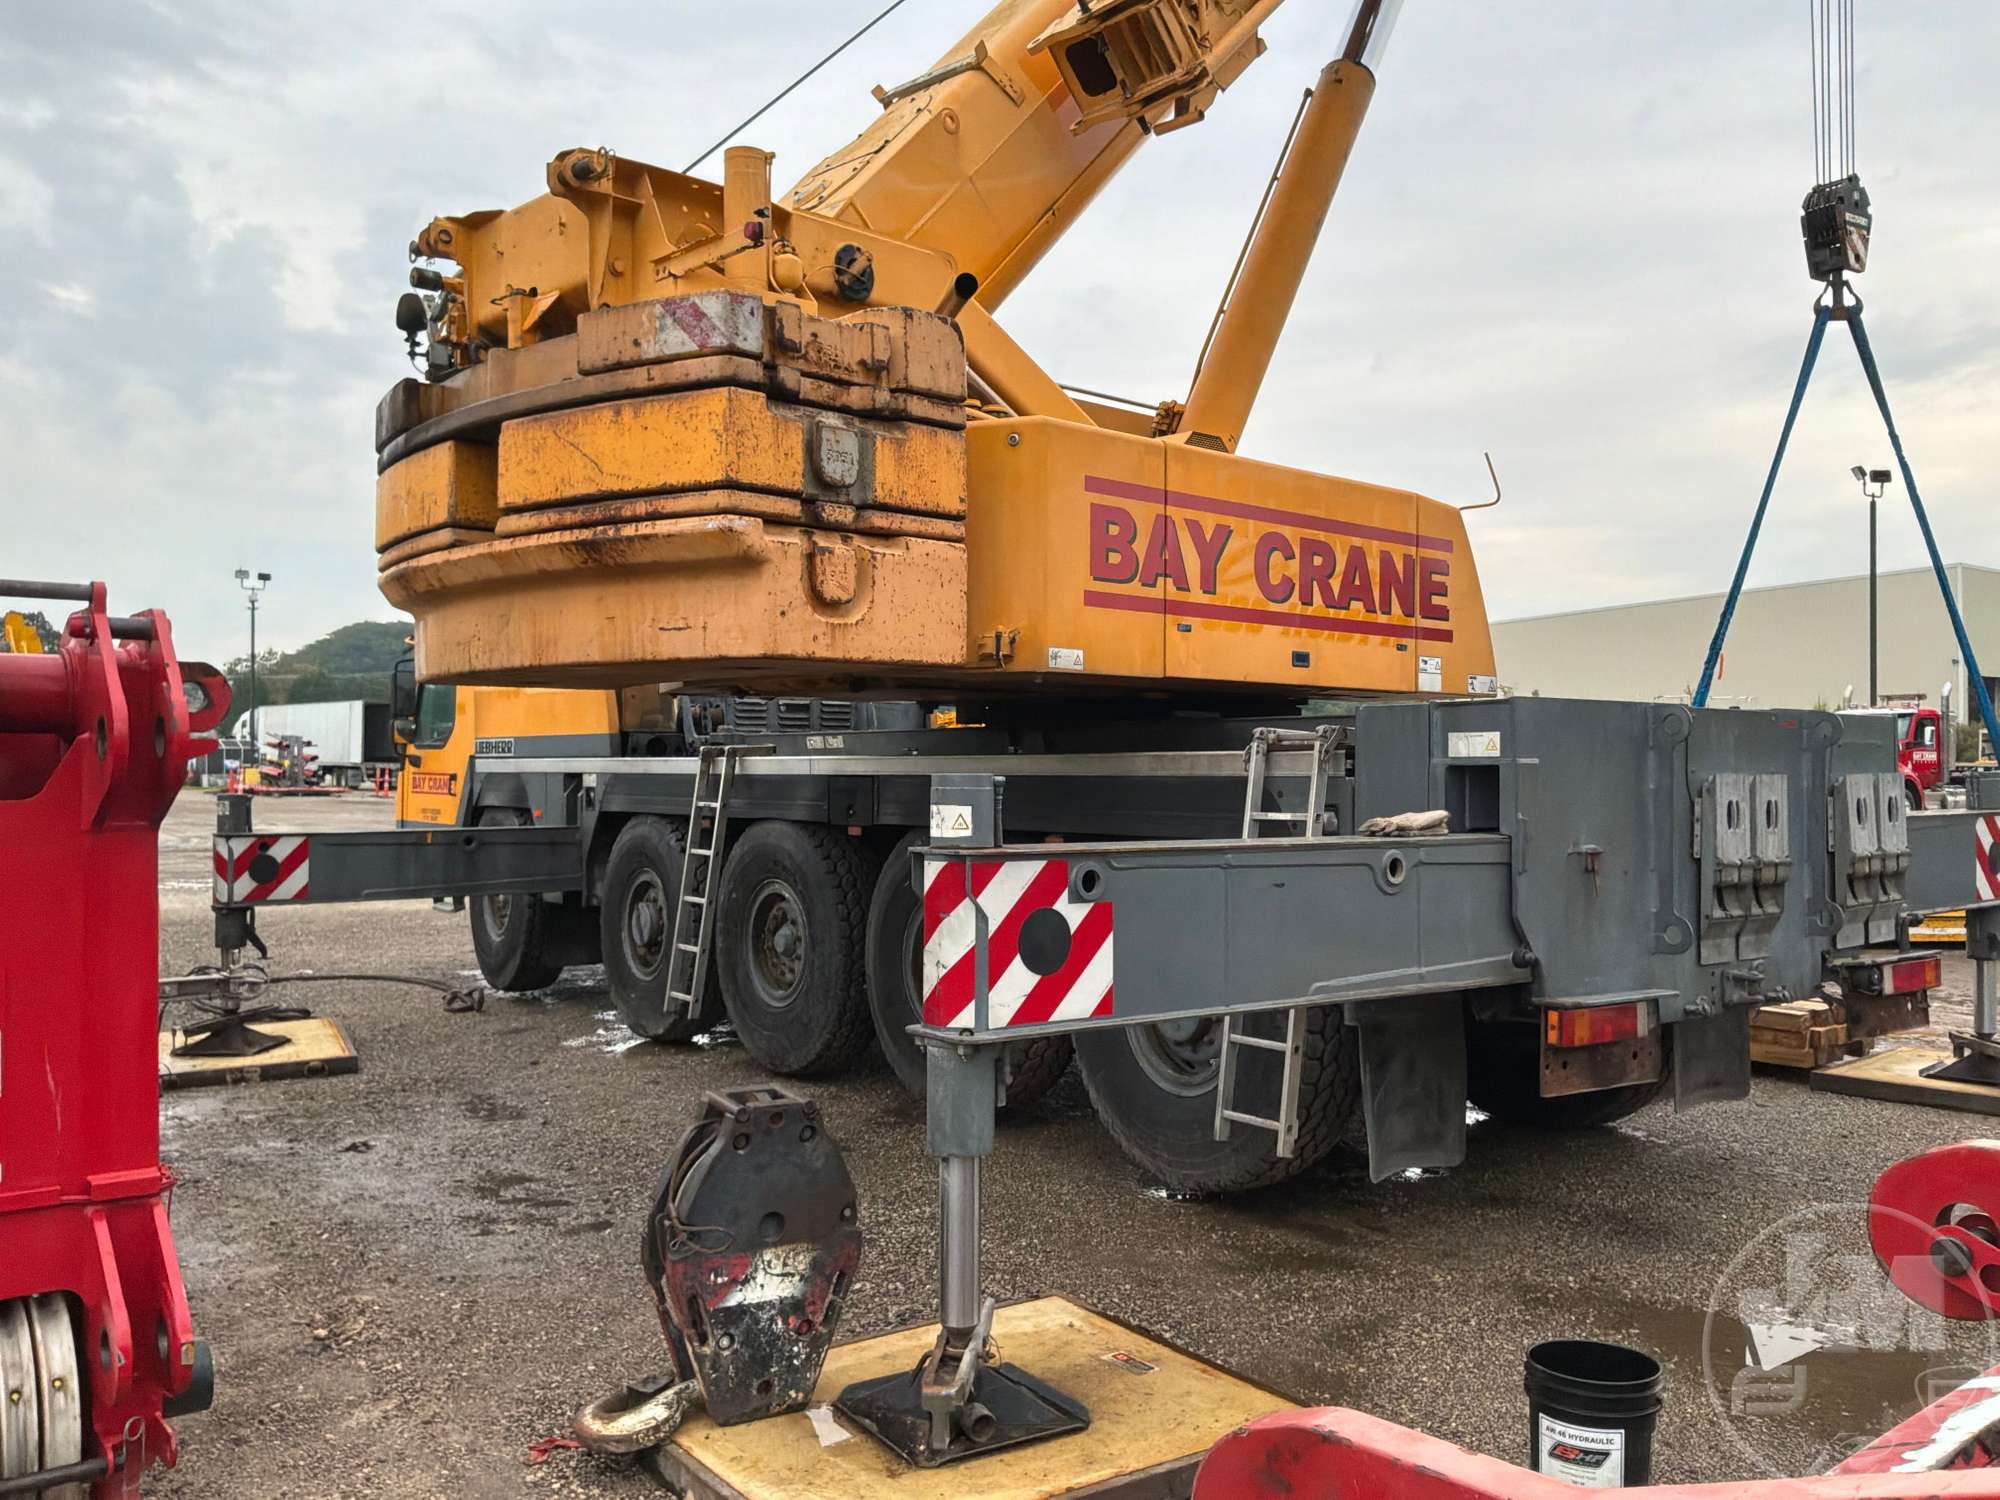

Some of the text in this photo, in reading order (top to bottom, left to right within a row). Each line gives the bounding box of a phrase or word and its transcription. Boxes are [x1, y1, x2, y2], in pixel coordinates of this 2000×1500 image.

[1090, 502, 1450, 622] BAY CRANE
[475, 740, 513, 754] LIEBHERR
[412, 776, 427, 790] BAY
[1568, 1433, 1615, 1445] HYDRAULIC
